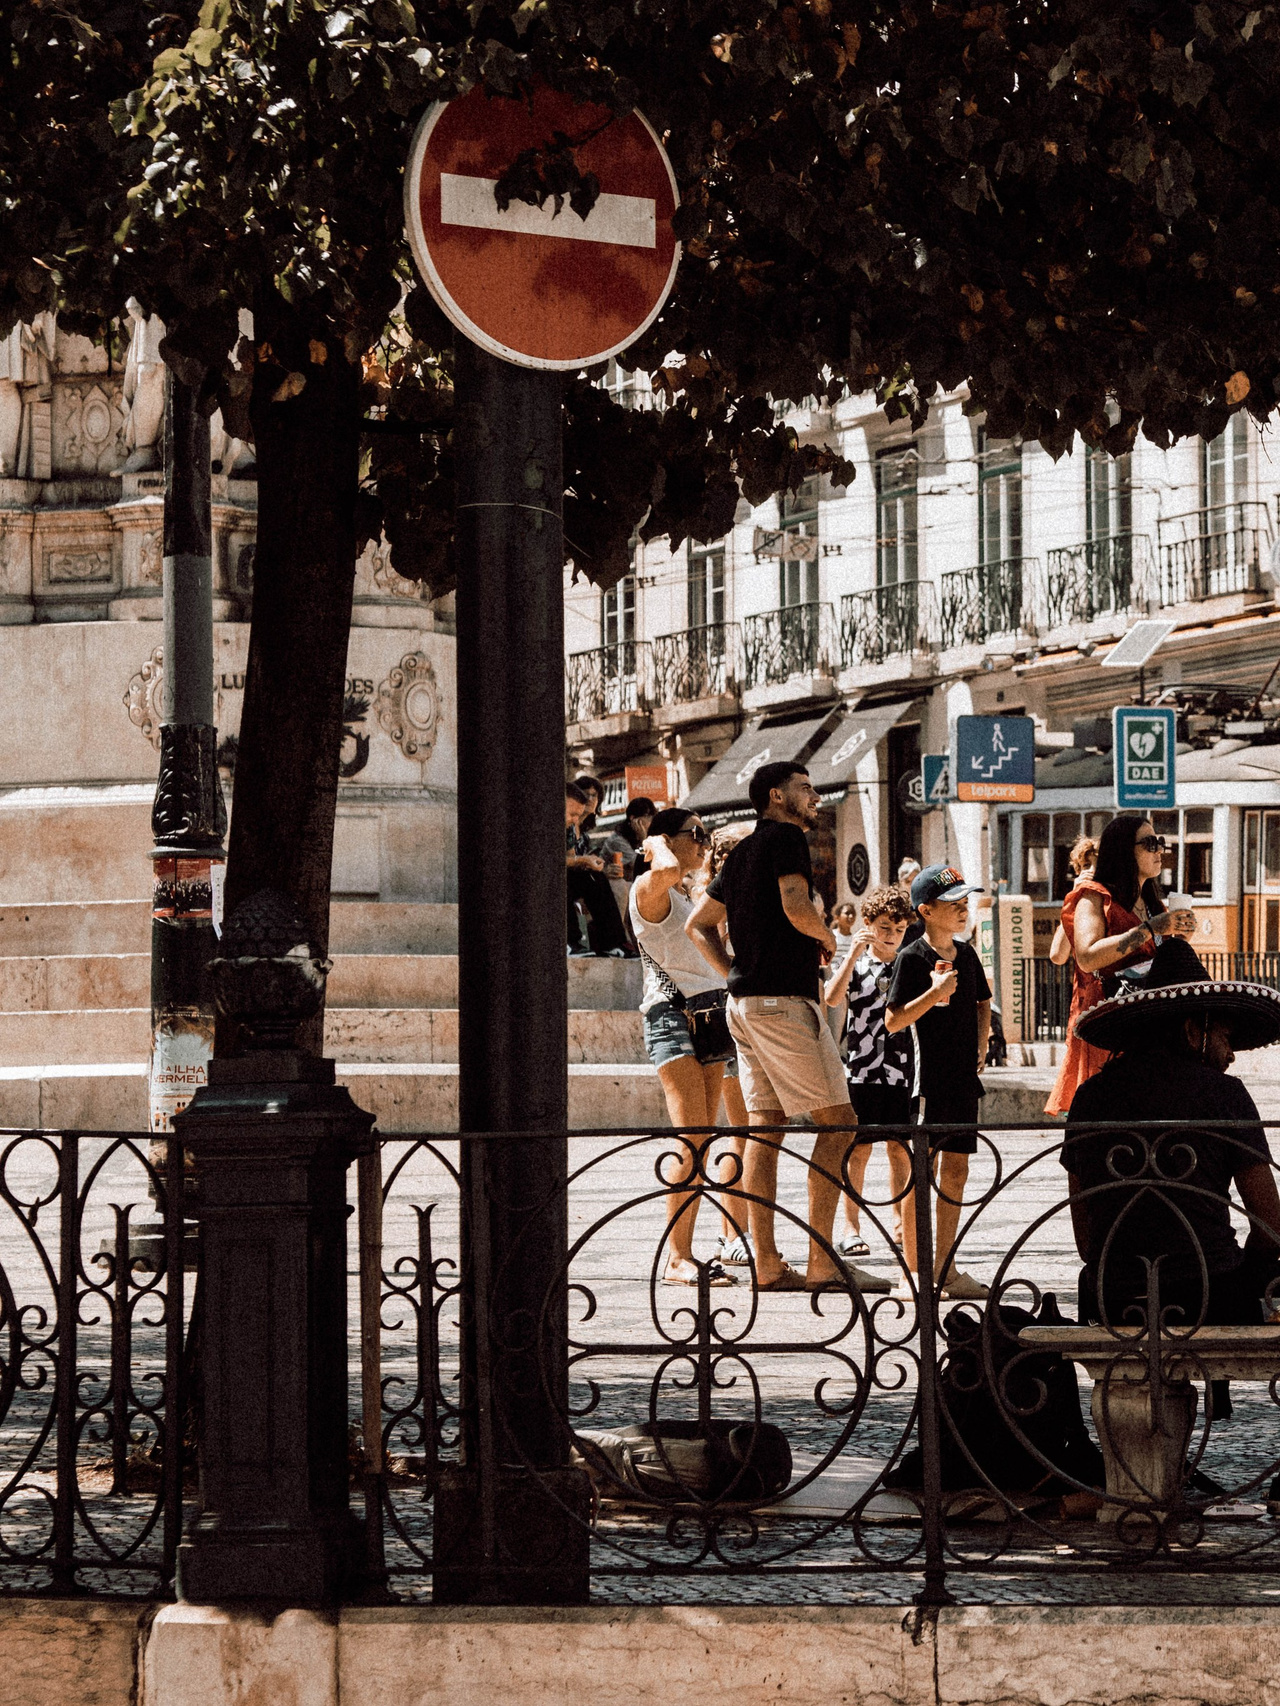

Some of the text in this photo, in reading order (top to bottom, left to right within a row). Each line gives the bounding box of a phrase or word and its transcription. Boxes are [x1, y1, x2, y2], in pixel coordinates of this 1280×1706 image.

[222, 674, 246, 690] LU
[1132, 767, 1160, 779] DAE
[971, 785, 1017, 798] telpark
[174, 1065, 205, 1074] ILHA
